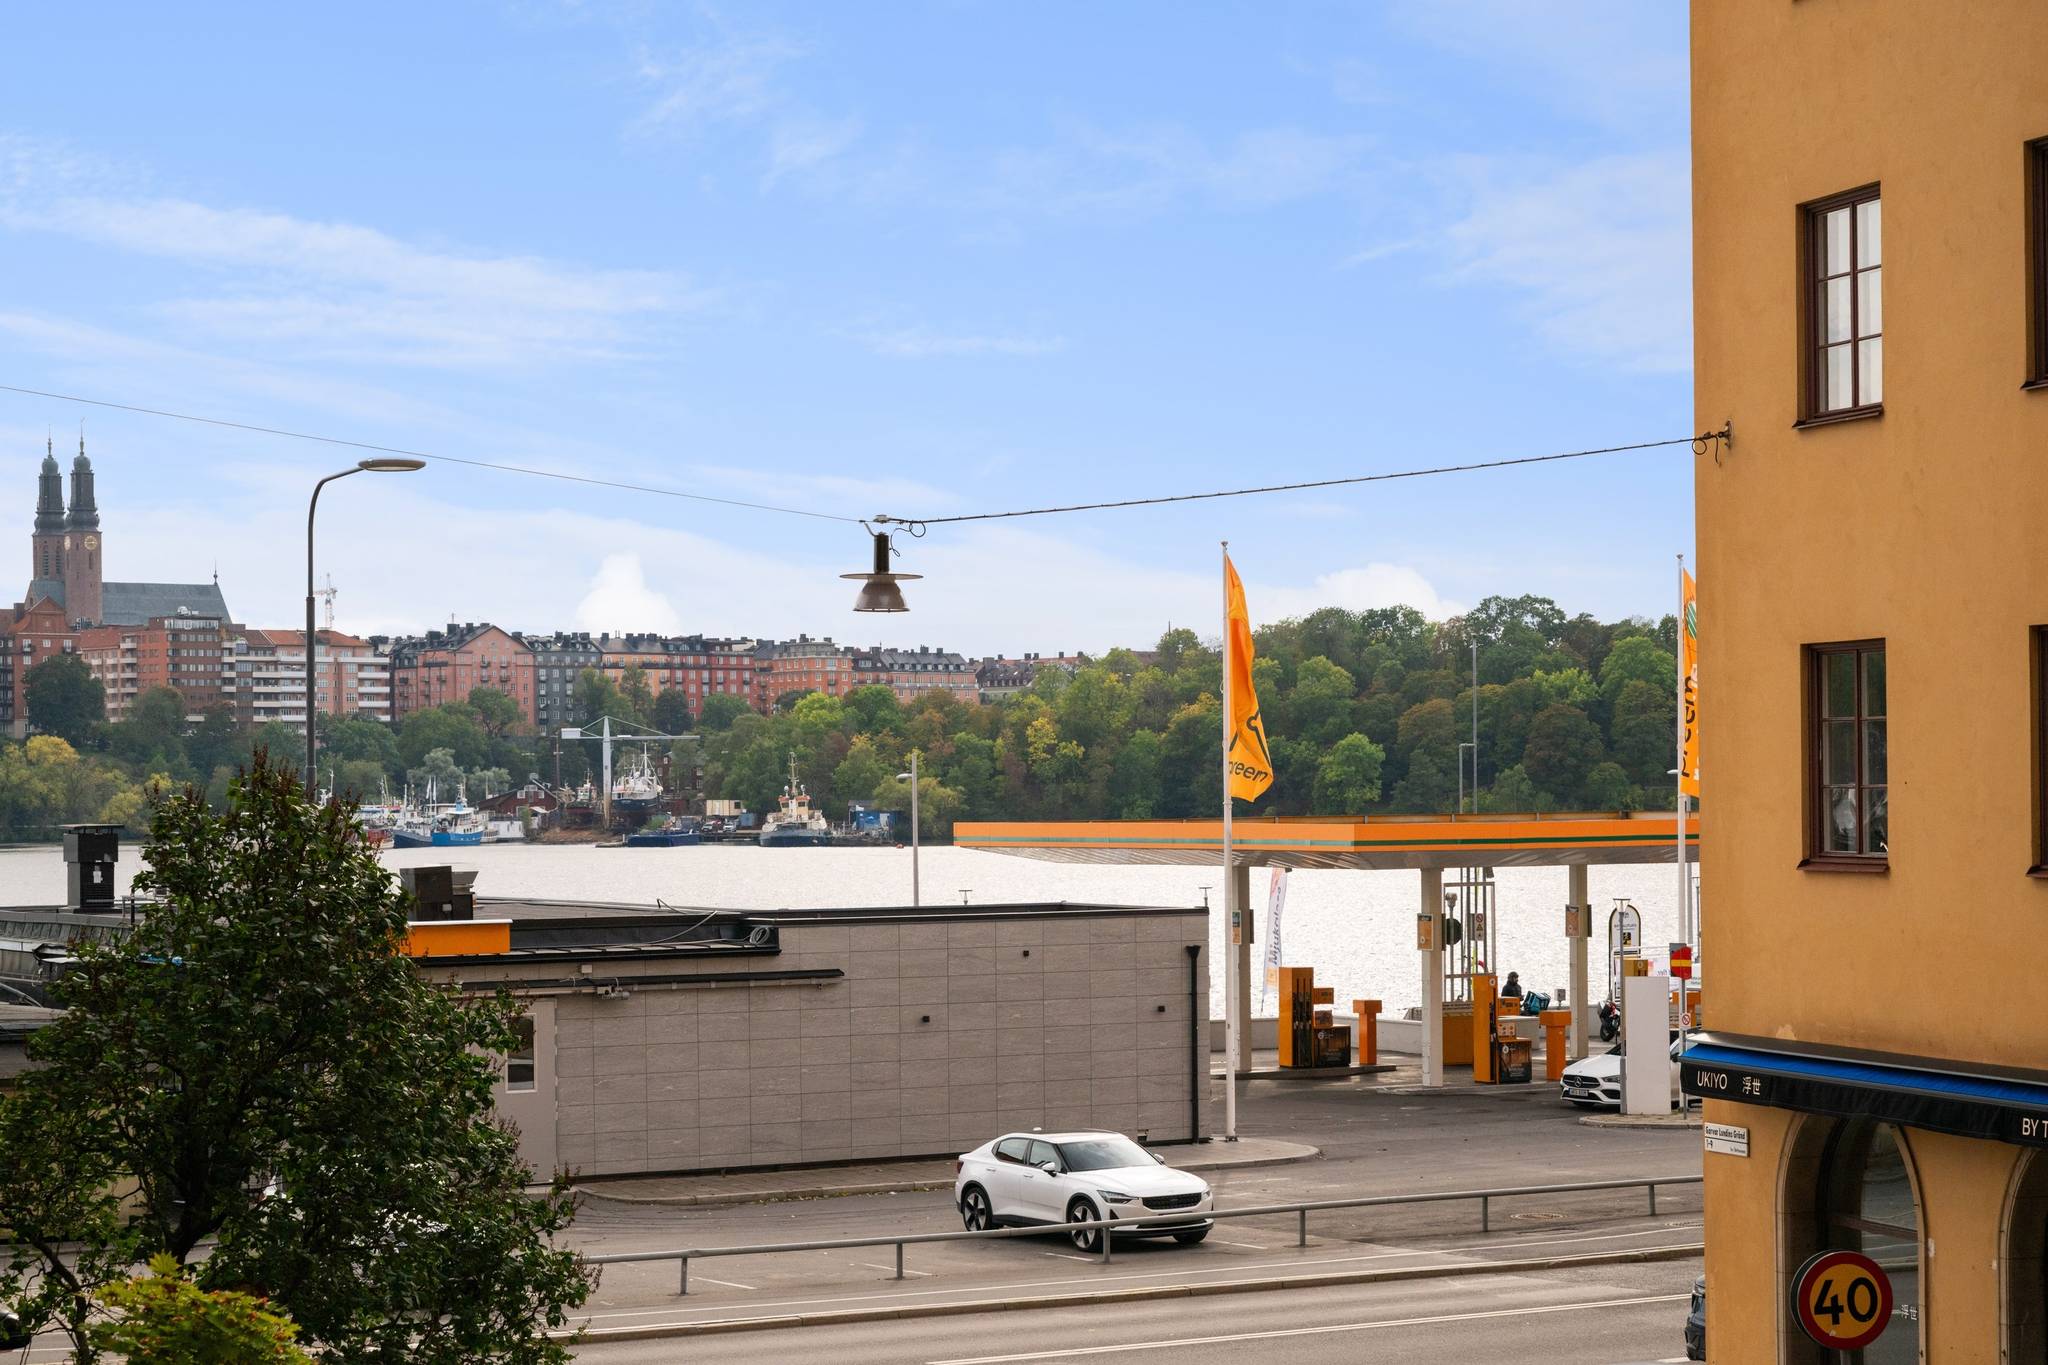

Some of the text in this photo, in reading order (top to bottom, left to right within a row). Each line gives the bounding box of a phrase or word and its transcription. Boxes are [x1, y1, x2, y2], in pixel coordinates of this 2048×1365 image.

[1697, 1070, 1728, 1090] UKIYO
[2022, 1117, 2039, 1137] BY
[1814, 1276, 1878, 1326] 40
